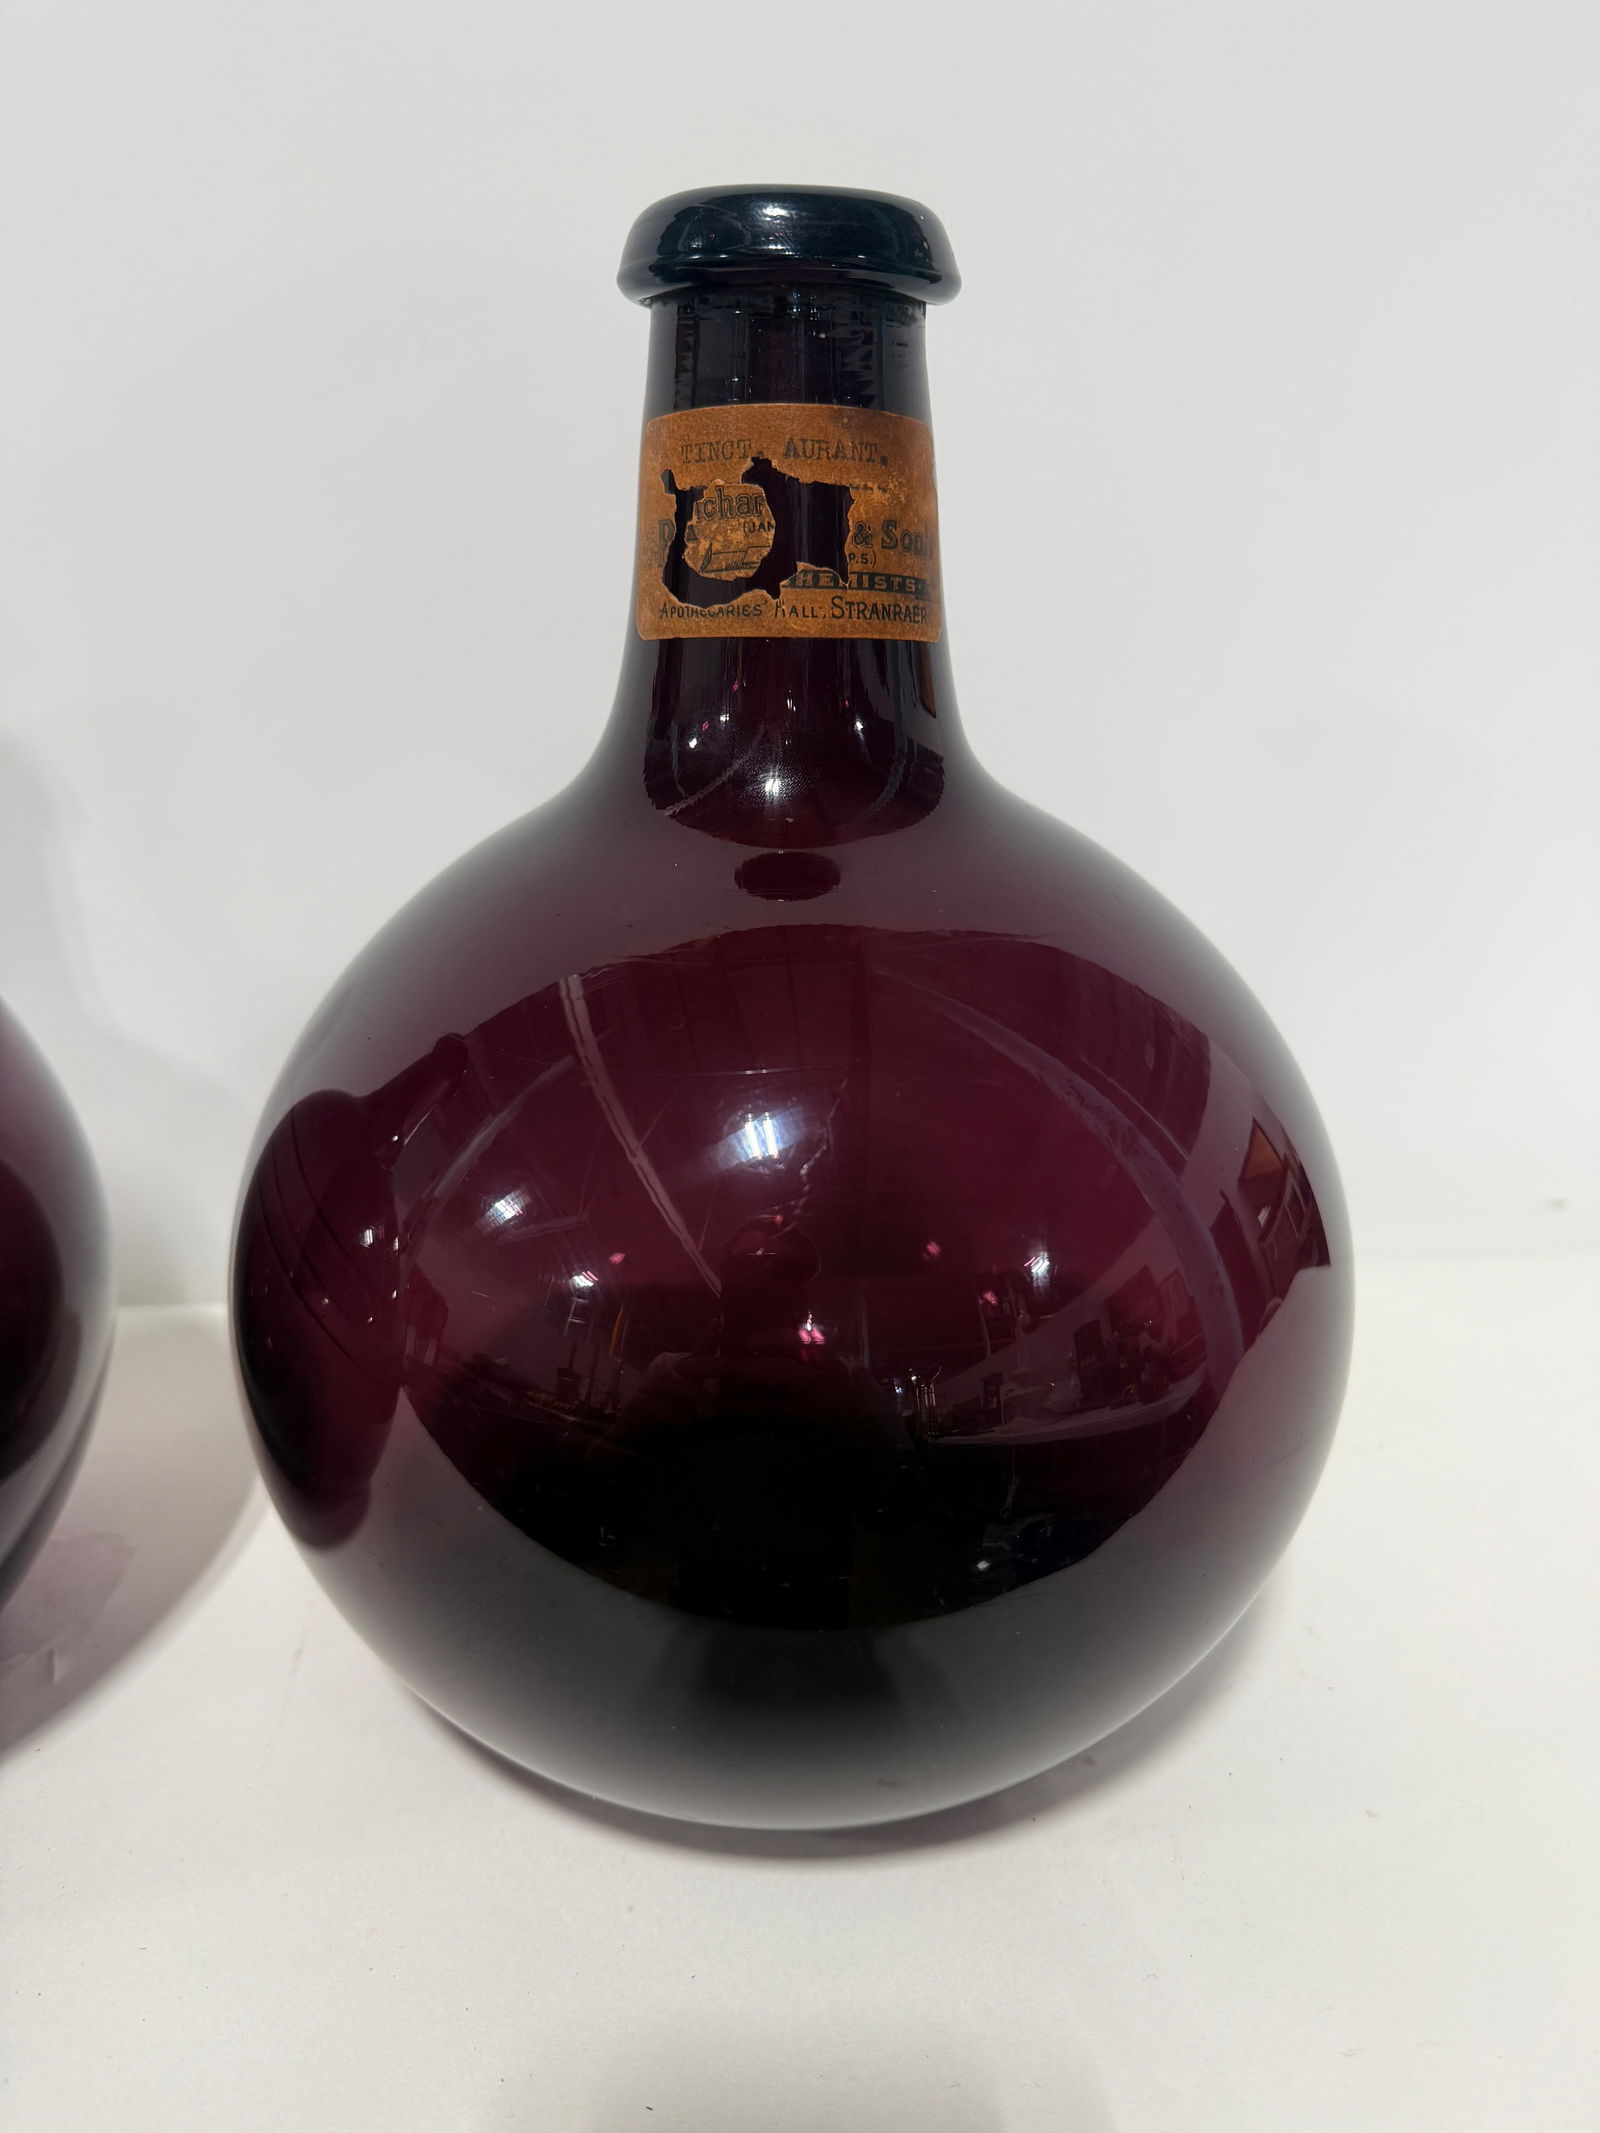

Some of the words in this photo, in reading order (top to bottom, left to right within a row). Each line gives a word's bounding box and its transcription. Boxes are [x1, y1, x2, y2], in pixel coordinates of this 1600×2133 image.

[783, 437, 889, 467] AURANT.
[848, 550, 877, 568] P.S.)
[795, 571, 917, 593] HEISTS
